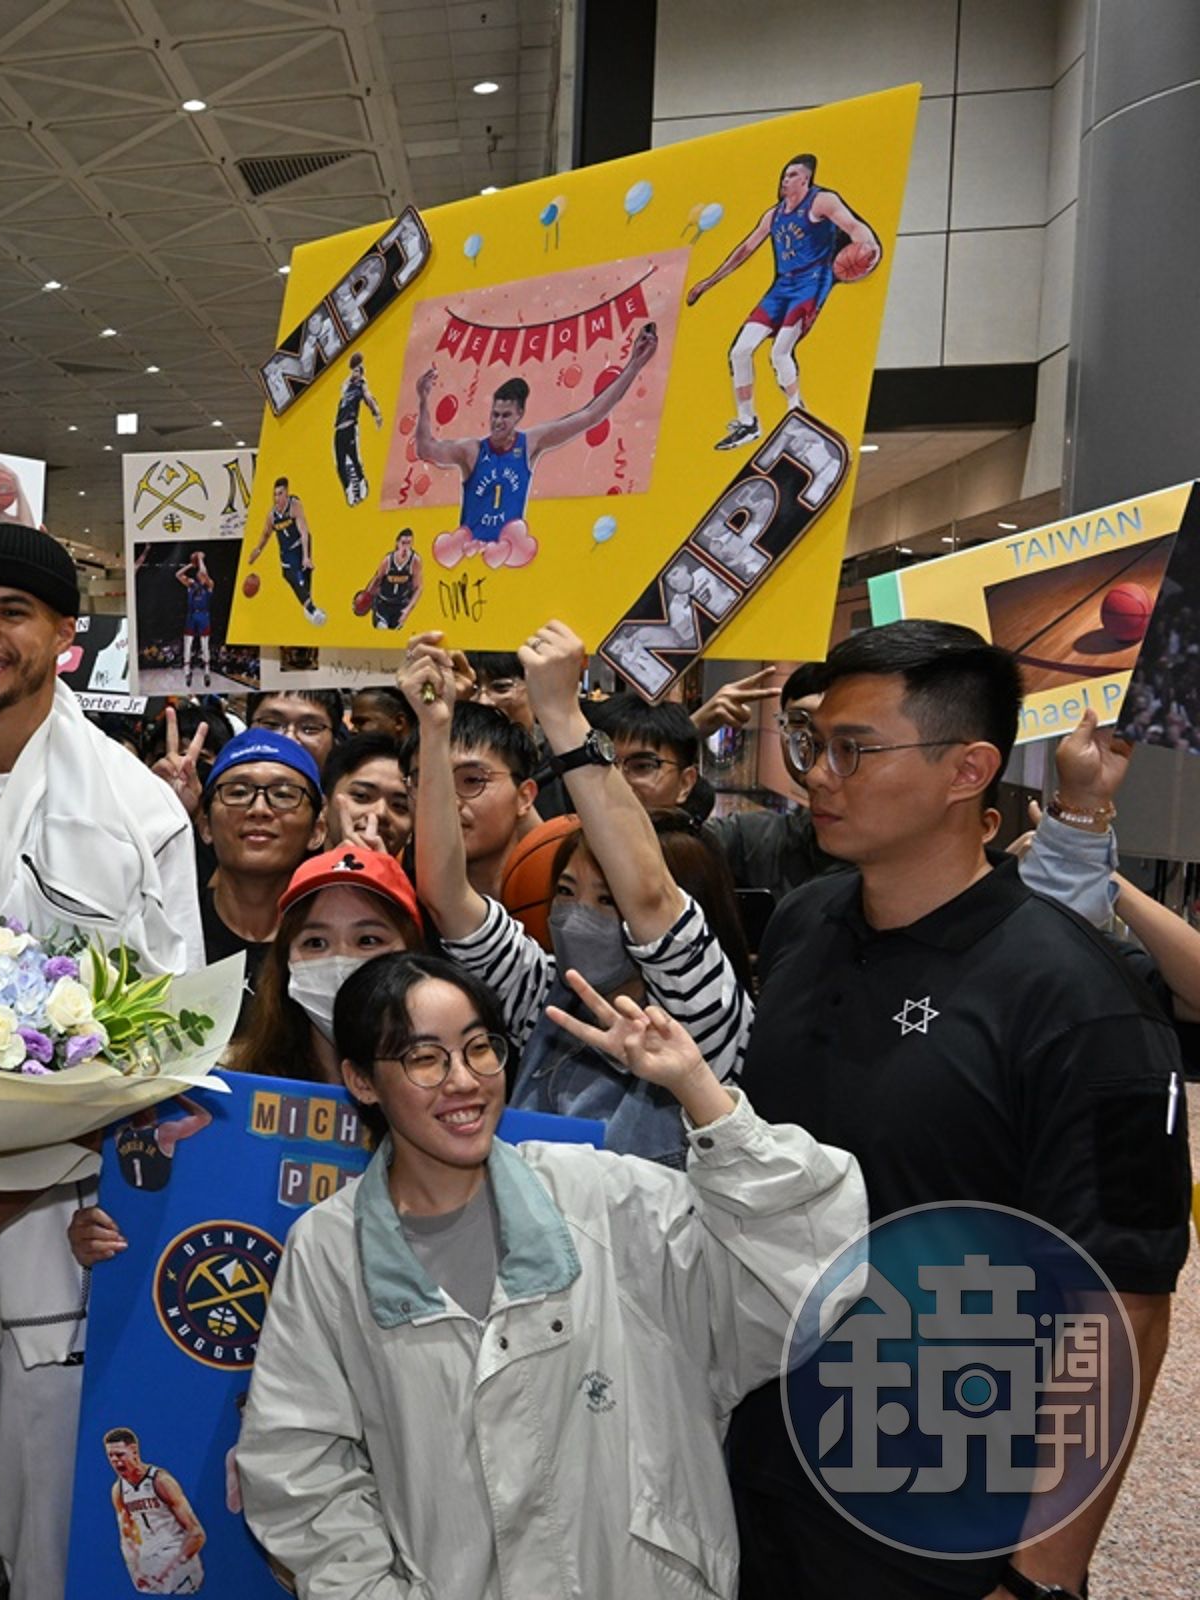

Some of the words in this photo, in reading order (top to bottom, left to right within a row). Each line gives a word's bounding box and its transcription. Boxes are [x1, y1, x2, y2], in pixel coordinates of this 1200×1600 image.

[259, 206, 431, 416] MPJ
[447, 298, 635, 353] WELCOME
[475, 467, 498, 496] MILE
[493, 484, 502, 509] 1
[481, 512, 506, 527] CITY
[1006, 506, 1144, 569] TAIWAN
[600, 408, 849, 703] MPJ
[1020, 687, 1090, 730] hael
[256, 1103, 357, 1143] MICH
[133, 1158, 143, 1187] 1
[287, 1167, 355, 1202] PO
[183, 1231, 278, 1265] DENVE
